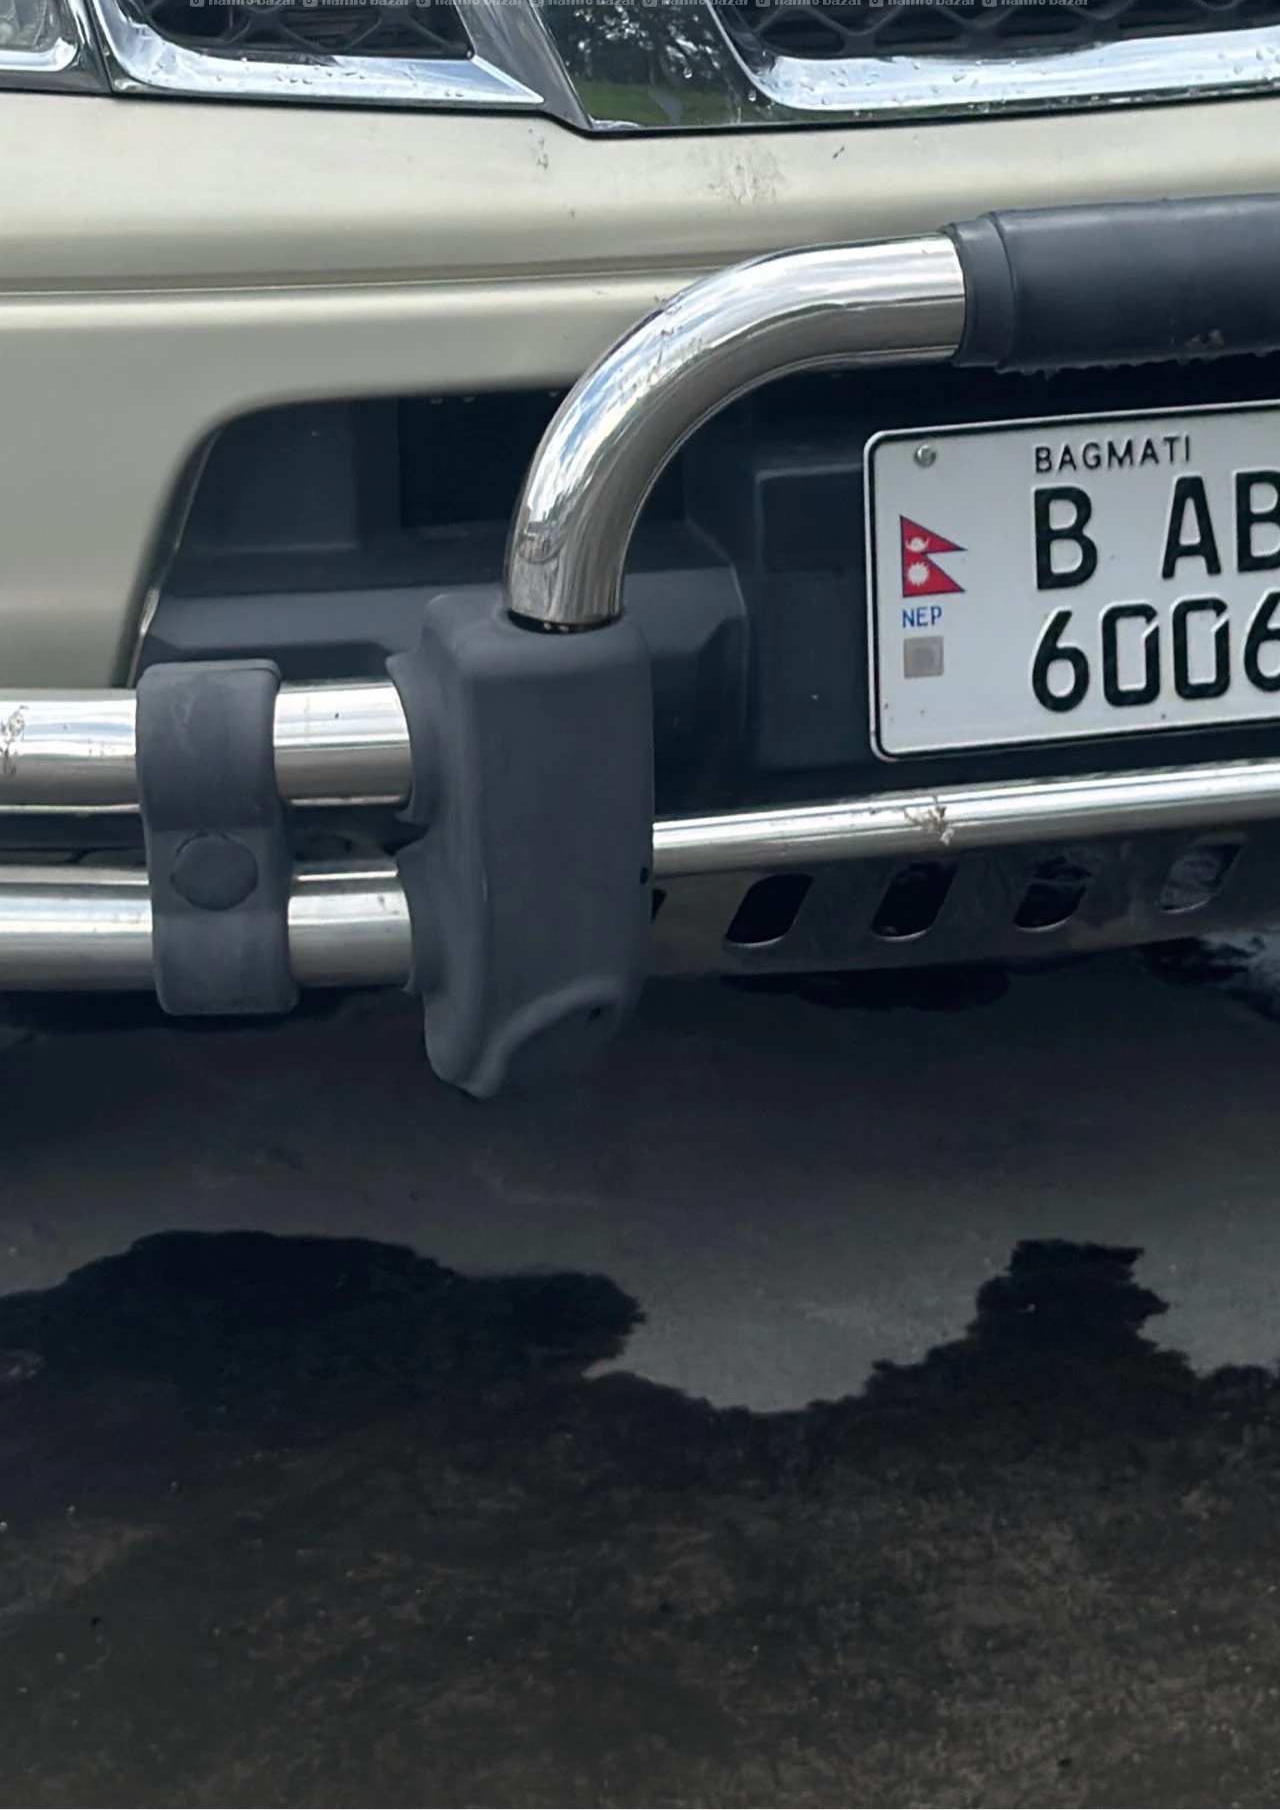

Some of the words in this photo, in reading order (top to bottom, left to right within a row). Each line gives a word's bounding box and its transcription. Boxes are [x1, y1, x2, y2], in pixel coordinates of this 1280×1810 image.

[1034, 435, 1193, 474] BAGMATI
[1032, 485, 1098, 591] B
[901, 606, 944, 628] NEP
